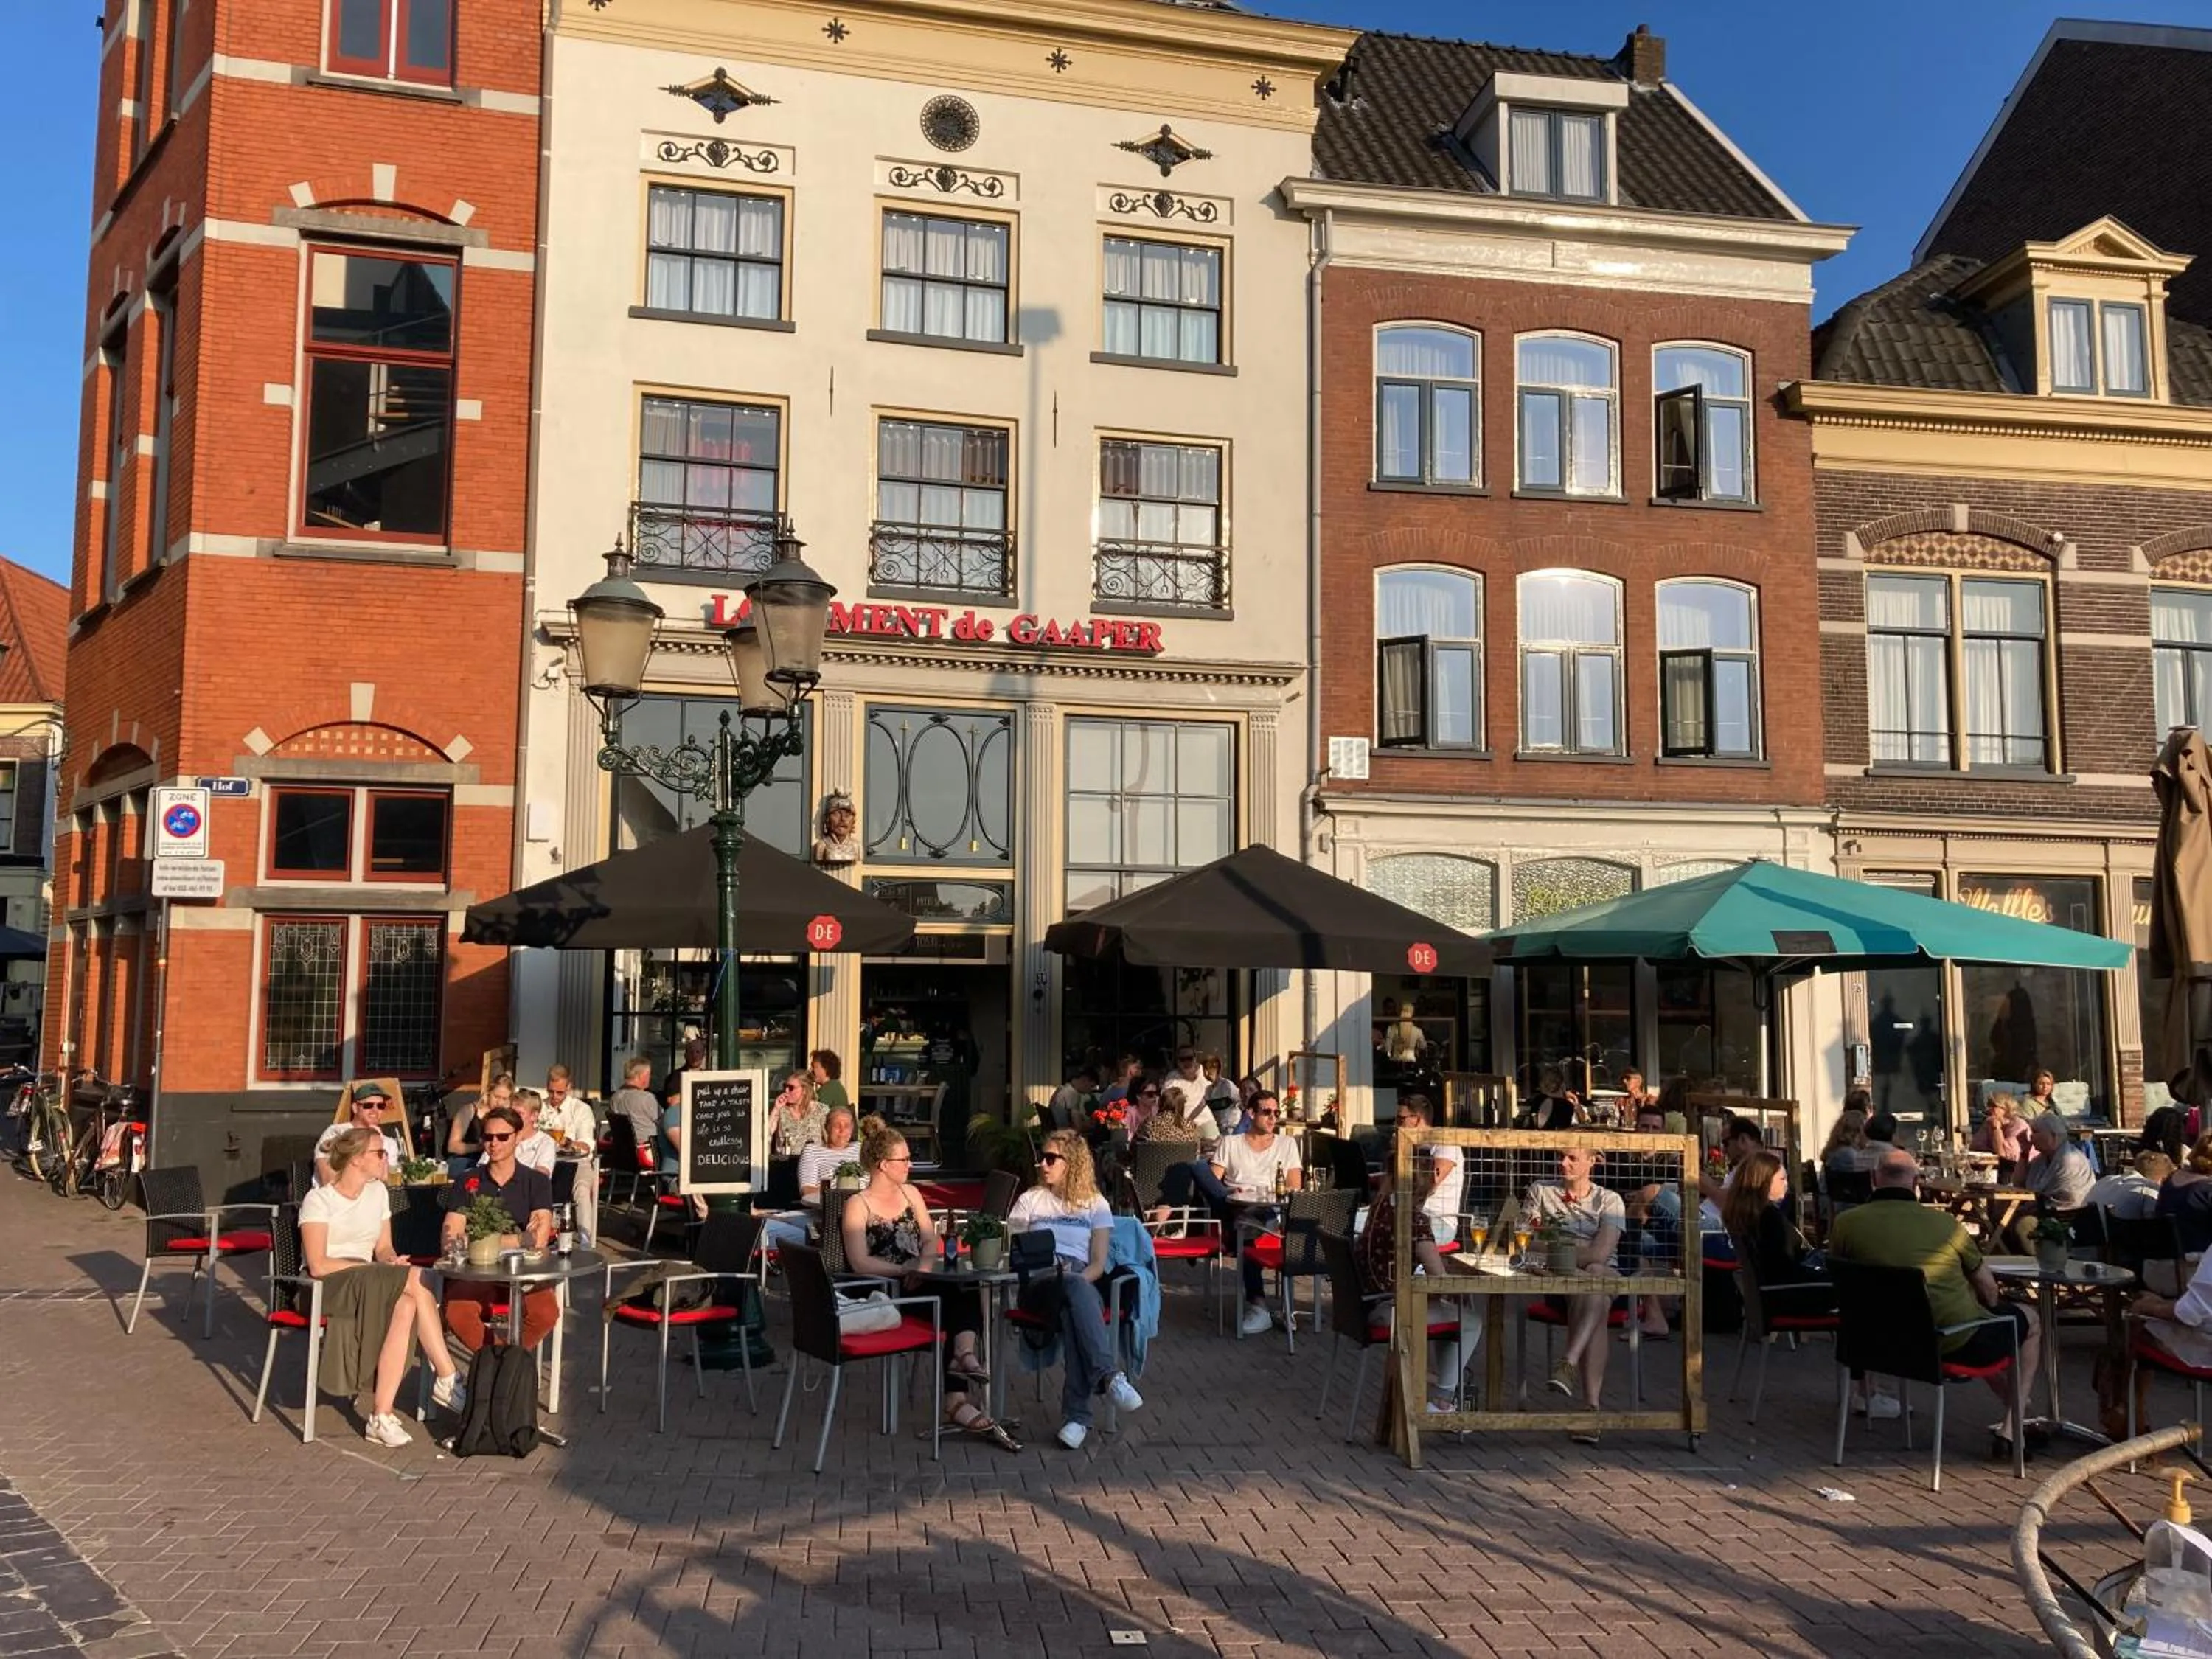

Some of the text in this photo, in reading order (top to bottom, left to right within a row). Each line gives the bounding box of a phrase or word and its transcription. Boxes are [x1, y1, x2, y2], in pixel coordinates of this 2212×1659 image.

[710, 593, 1165, 652] LMENT de GAAPER
[211, 780, 234, 791] Hof
[168, 793, 197, 801] ZONE
